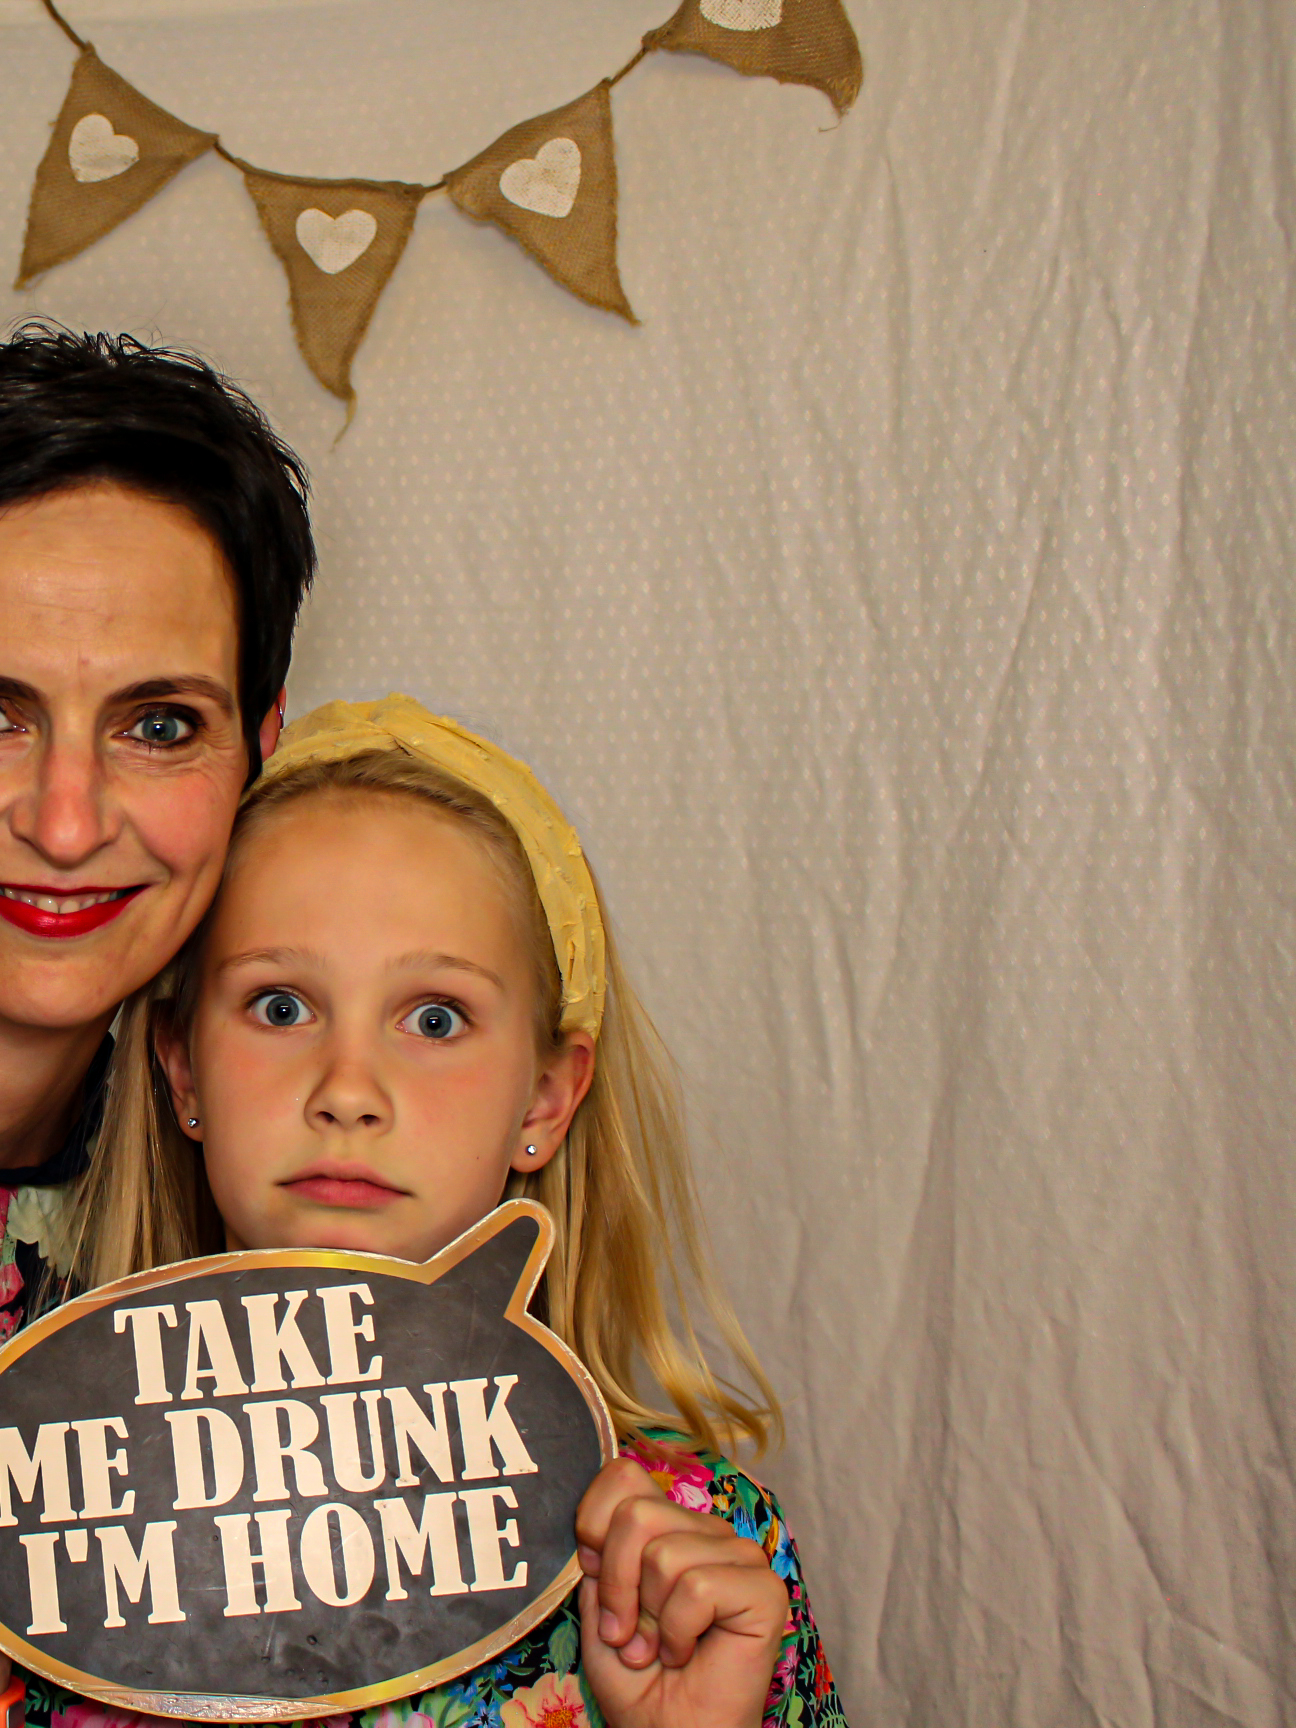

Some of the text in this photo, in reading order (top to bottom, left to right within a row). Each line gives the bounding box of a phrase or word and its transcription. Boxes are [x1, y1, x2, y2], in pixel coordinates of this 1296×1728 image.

[113, 1283, 383, 1405] TAKE
[163, 1374, 539, 1510] DRUNK
[18, 1485, 528, 1635] I'M HOME
